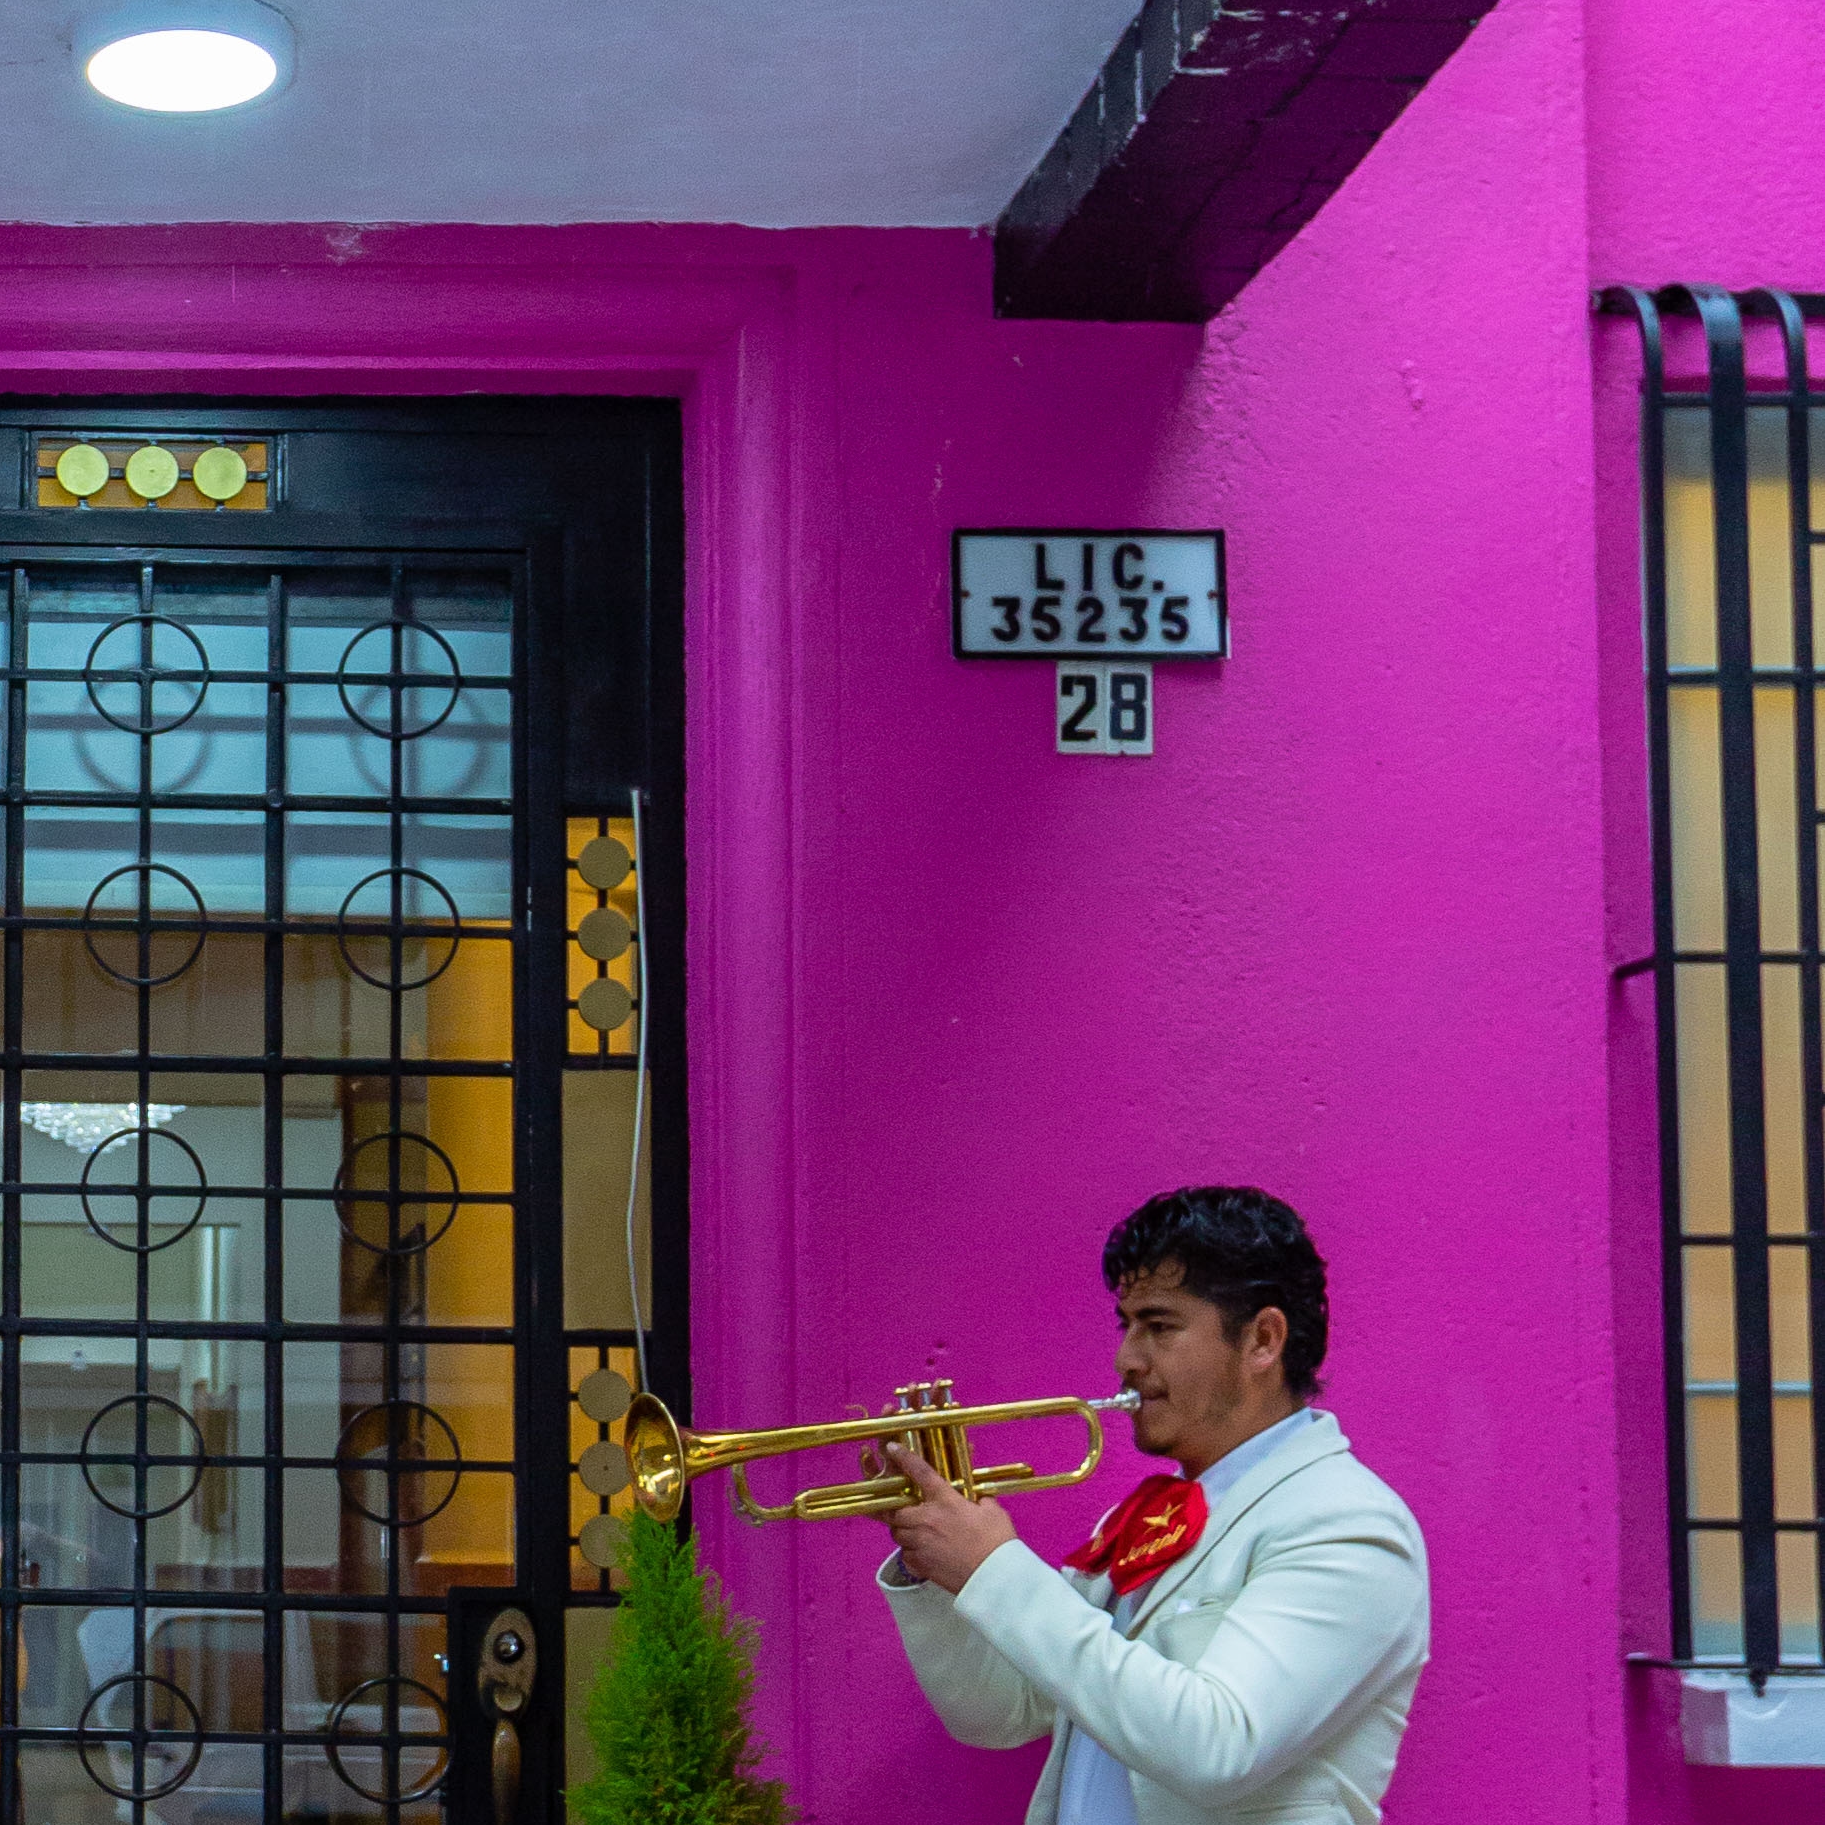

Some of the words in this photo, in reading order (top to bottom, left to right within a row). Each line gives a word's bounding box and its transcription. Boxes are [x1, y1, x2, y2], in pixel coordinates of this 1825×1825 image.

[1035, 542, 1165, 592] LIC.
[990, 595, 1190, 644] 35235
[1060, 672, 1148, 743] 28
